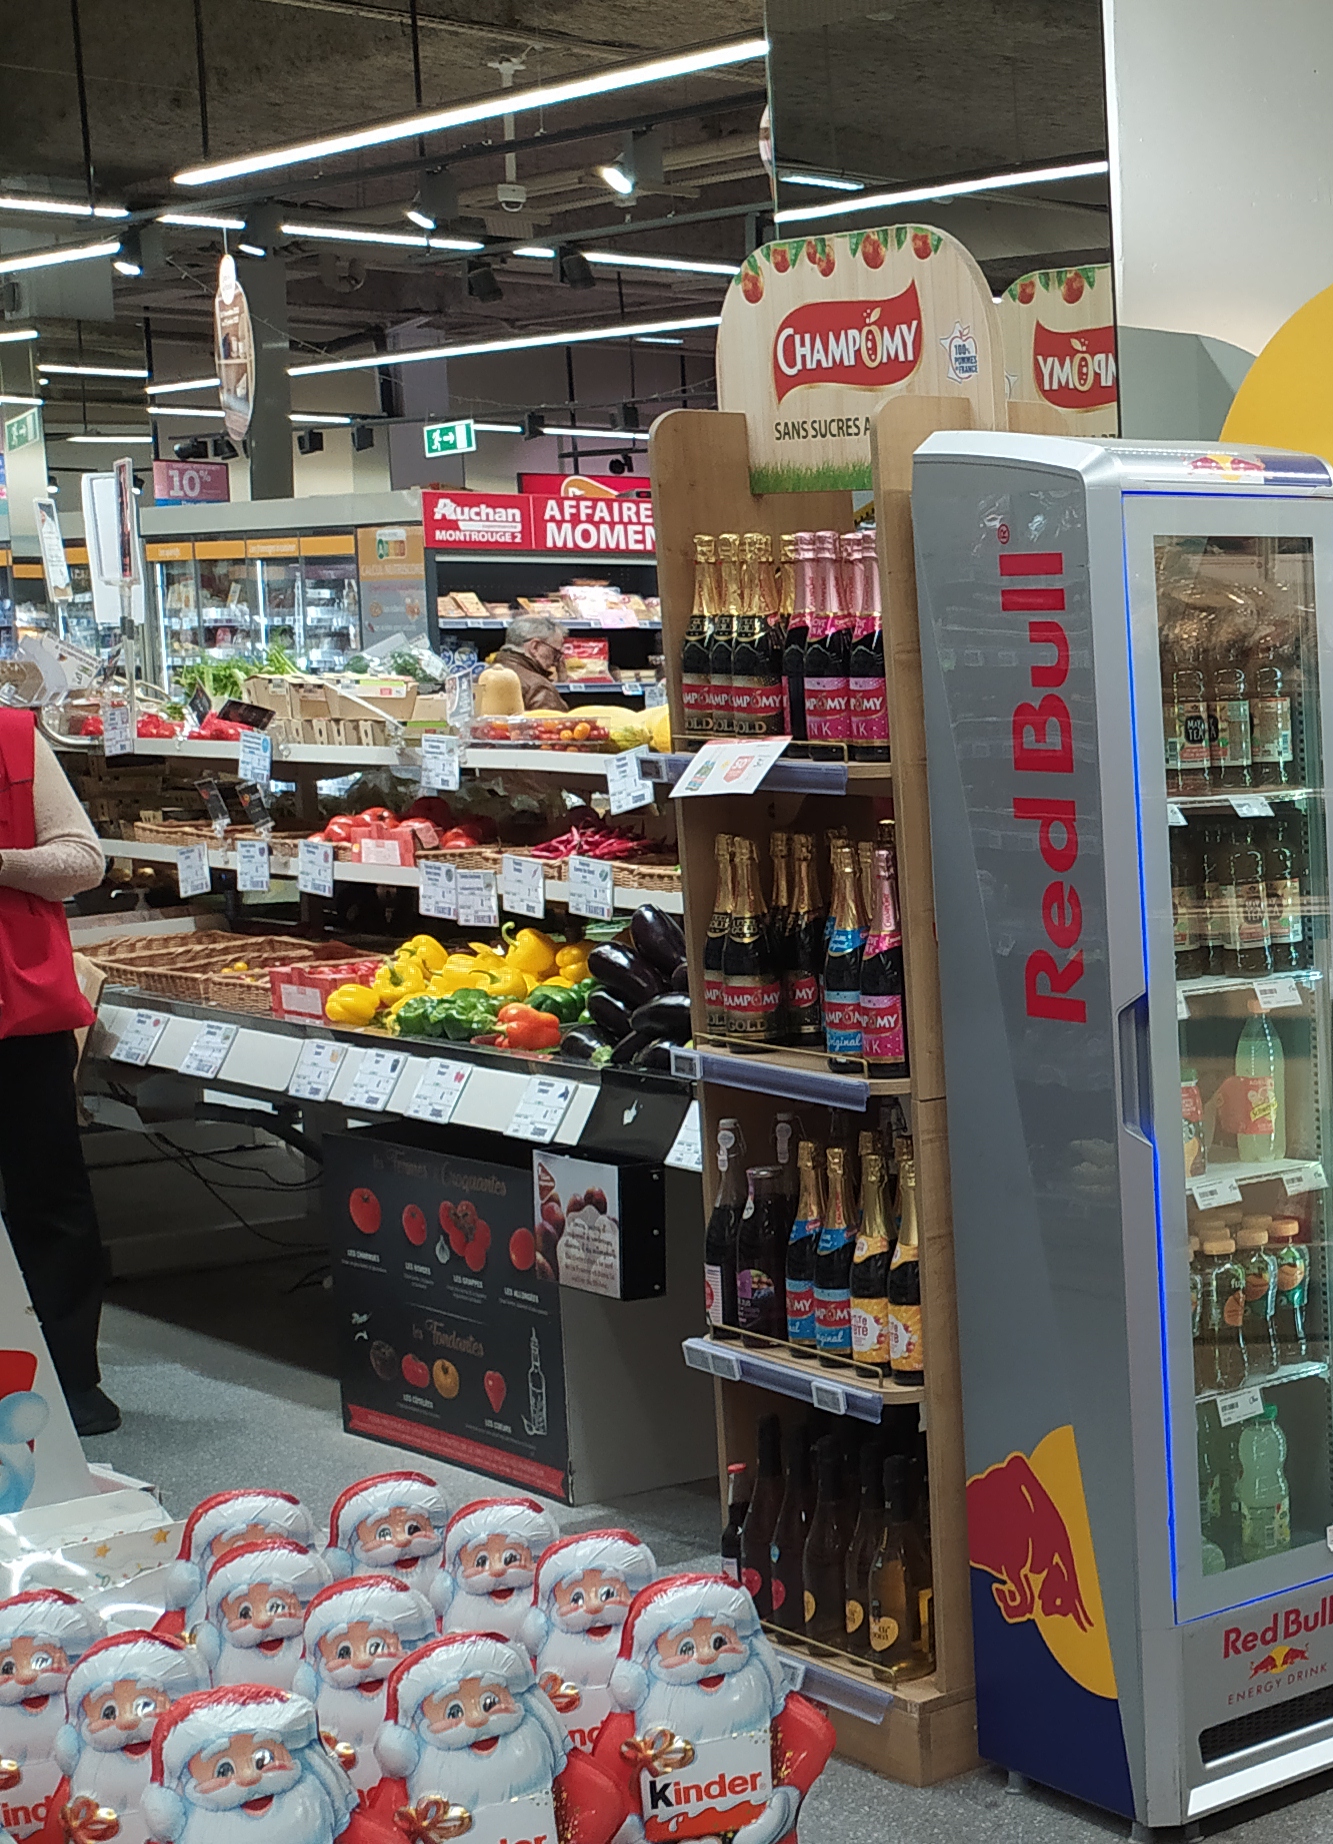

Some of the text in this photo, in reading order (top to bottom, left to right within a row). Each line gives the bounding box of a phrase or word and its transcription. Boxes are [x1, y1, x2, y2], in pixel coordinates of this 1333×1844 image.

[776, 310, 919, 377] CHAMPOMY
[774, 416, 858, 442] SANS SUCRES
[434, 498, 521, 522] Auchan
[435, 530, 522, 543] MONTROUGE 2
[998, 552, 1088, 1024] Red Bull
[728, 1018, 768, 1032] GOLD
[1223, 1612, 1279, 1659] Red
[1228, 1662, 1328, 1702] ENERGY DRINK
